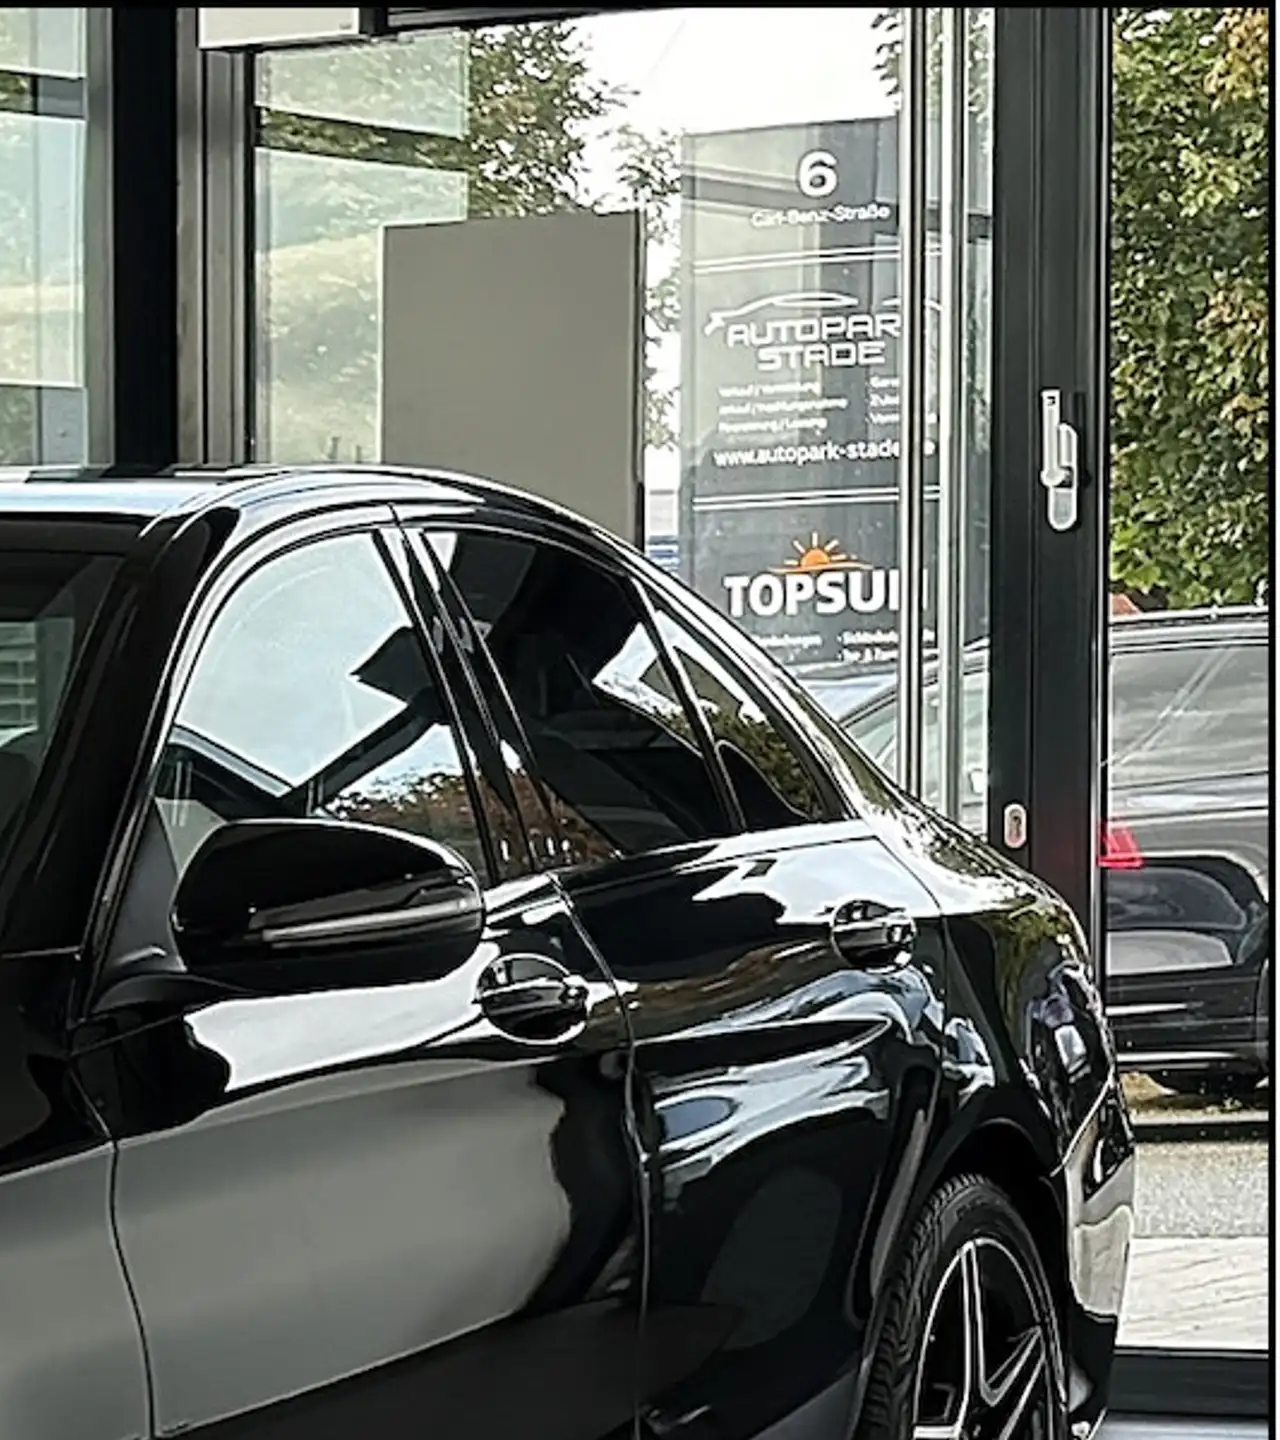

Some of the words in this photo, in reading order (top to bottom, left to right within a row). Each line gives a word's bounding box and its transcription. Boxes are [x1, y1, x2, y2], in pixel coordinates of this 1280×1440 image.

[797, 148, 839, 198] 6
[727, 314, 902, 346] AUTOPAR
[757, 341, 886, 371] STADE
